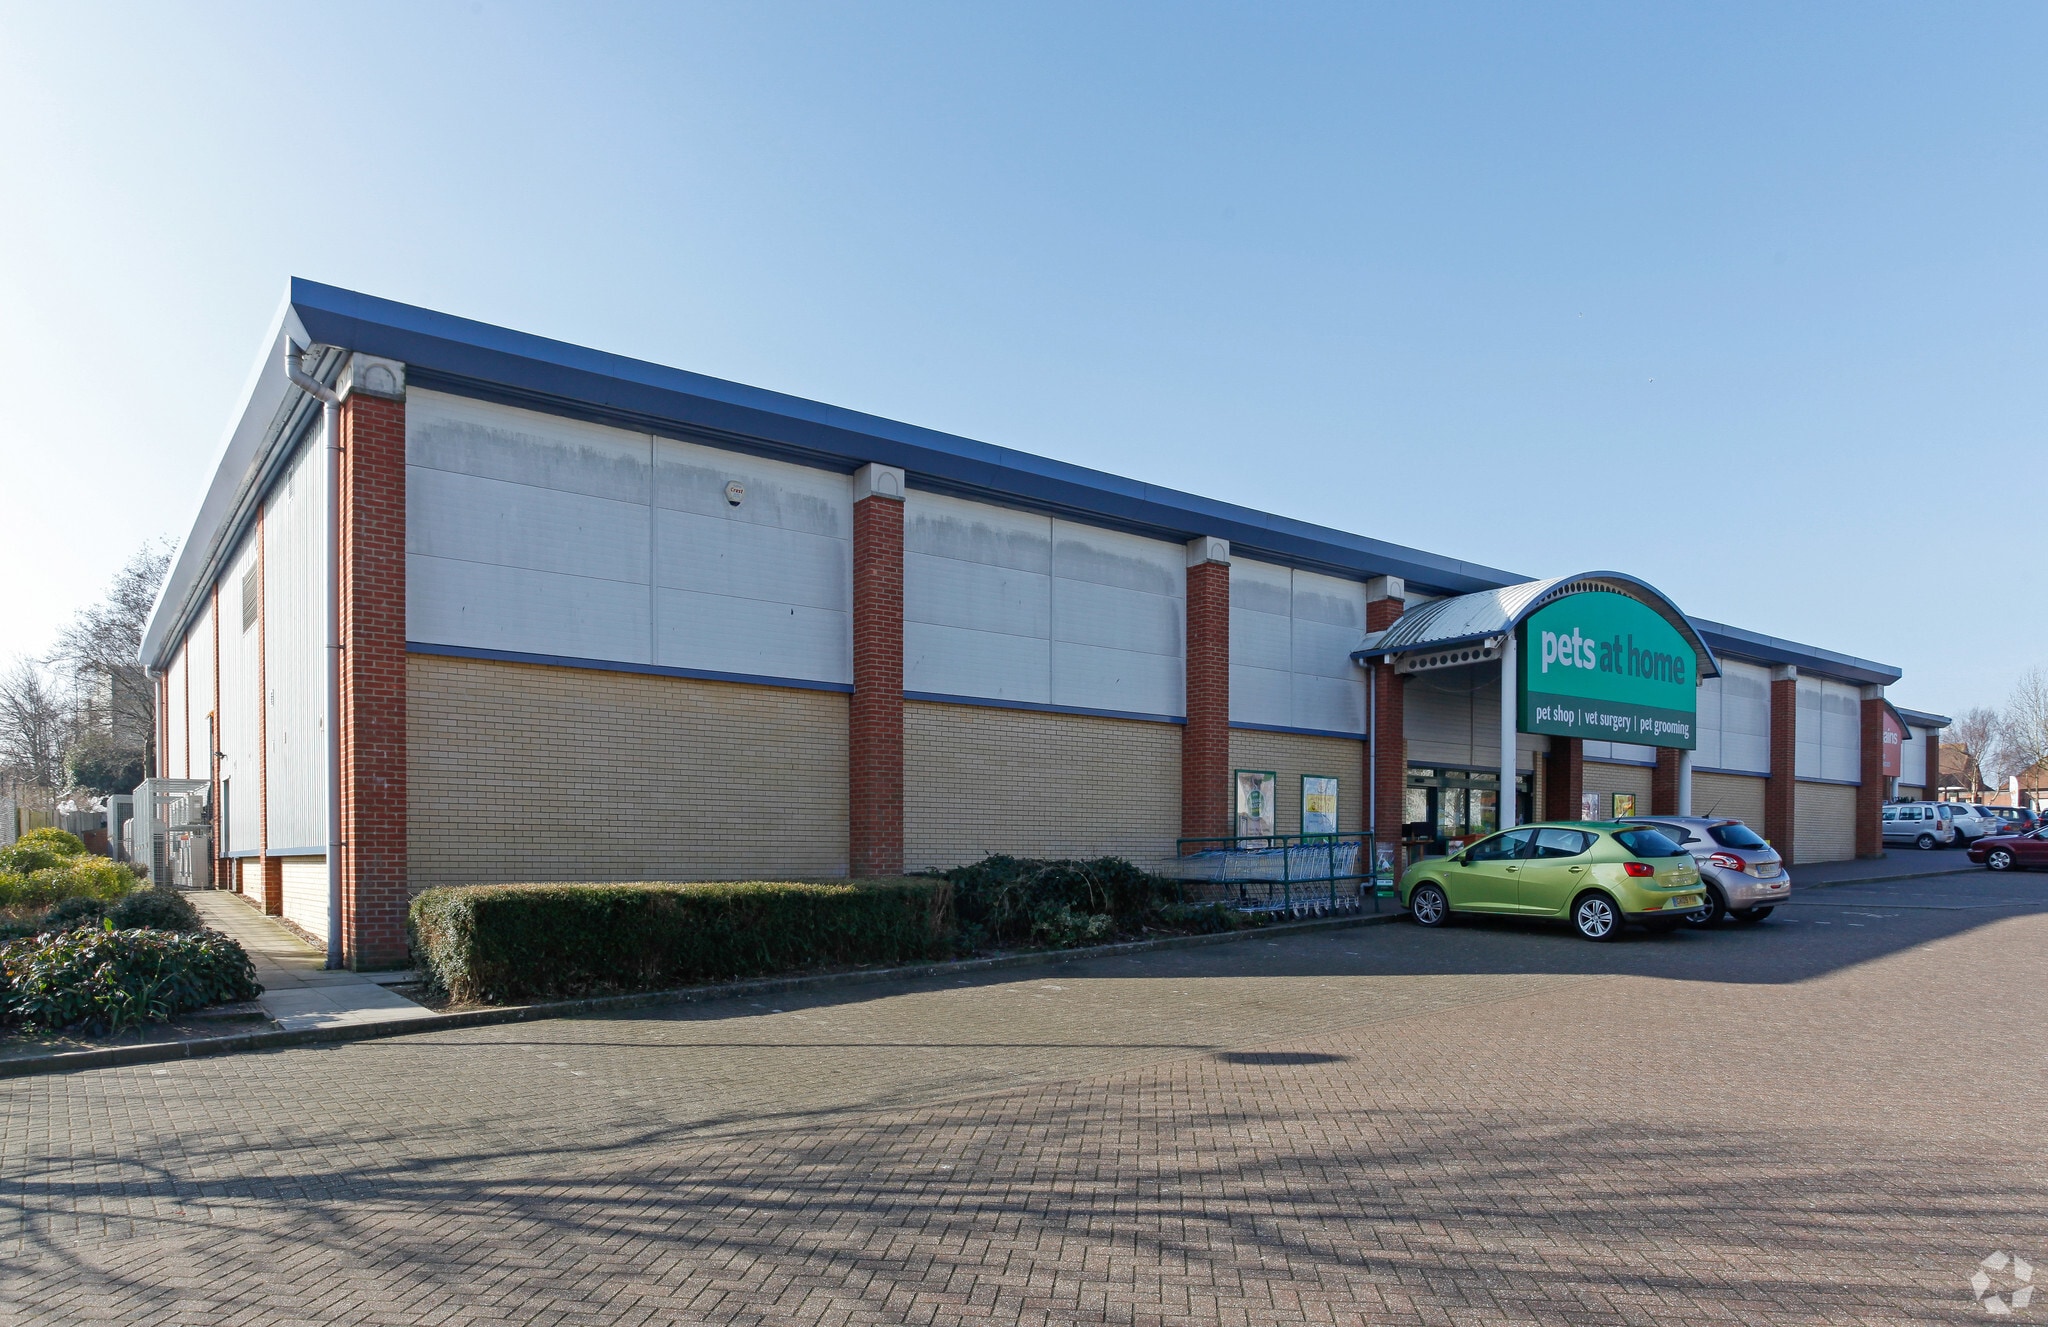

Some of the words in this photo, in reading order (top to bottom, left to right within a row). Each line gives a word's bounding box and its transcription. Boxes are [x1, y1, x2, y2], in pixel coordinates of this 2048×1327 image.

[1541, 627, 1596, 674] pets
[1600, 634, 1623, 675] at
[1627, 634, 1685, 685] home
[1536, 705, 1551, 724] pet
[1553, 704, 1575, 727] shop
[1584, 711, 1598, 726] vet
[1600, 714, 1632, 733] surgery
[1640, 717, 1653, 734] pet
[1654, 719, 1690, 739] grooming
